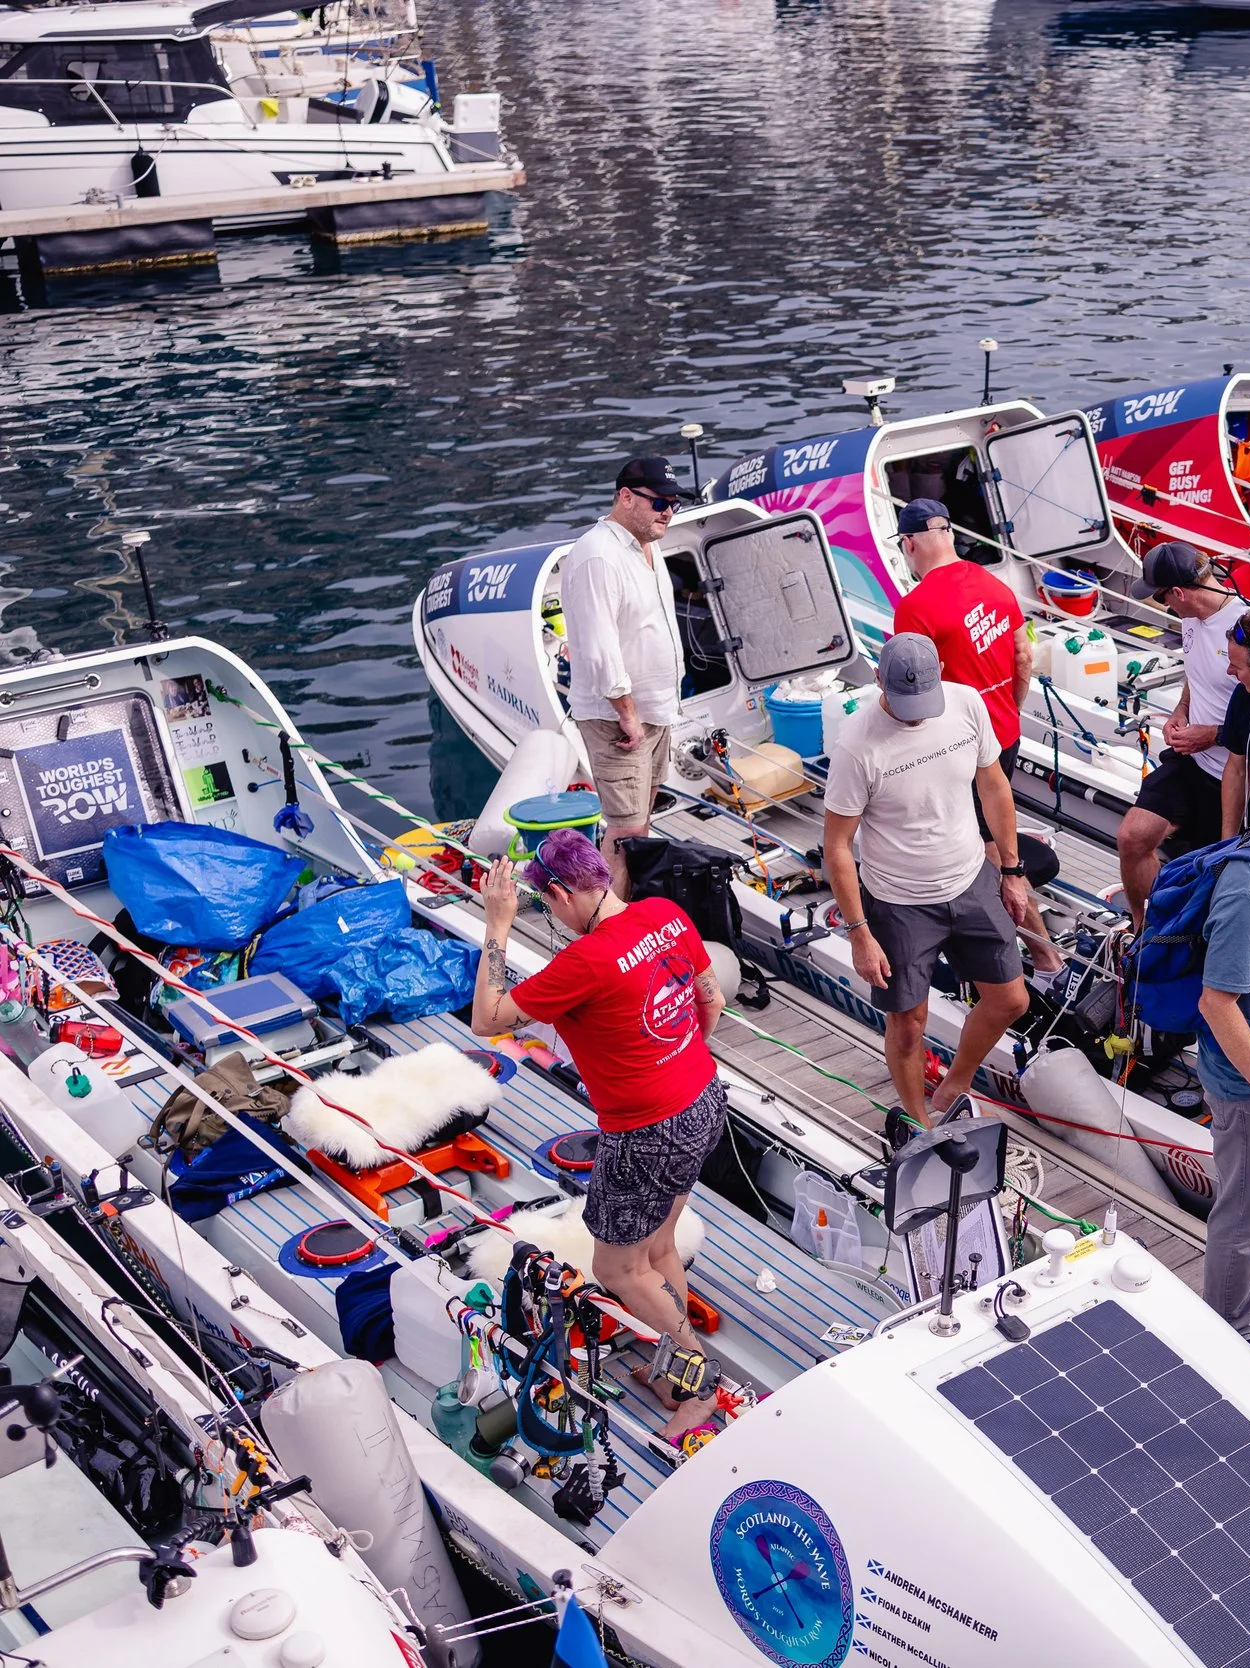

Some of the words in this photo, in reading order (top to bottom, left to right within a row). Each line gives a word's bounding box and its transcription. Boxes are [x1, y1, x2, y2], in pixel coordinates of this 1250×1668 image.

[1123, 388, 1186, 425] ROW
[729, 455, 766, 482] WORLD'S
[783, 439, 839, 478] ROW
[1168, 460, 1194, 476] GET
[727, 467, 768, 498] TOUGHEST
[1168, 474, 1201, 492] BUSY
[1168, 488, 1213, 507] LIVING!
[467, 562, 517, 603] ROW
[964, 602, 985, 629] GET
[969, 608, 997, 642] BUSY
[975, 614, 1011, 655] LIVING!
[487, 674, 541, 727] HADRIAN
[39, 756, 116, 786] WORLD'S
[888, 760, 916, 778] OCEAN
[916, 747, 948, 767] ROWING
[948, 733, 978, 752] COMPANY
[36, 767, 124, 800] TOUGHEST
[40, 781, 129, 825] ROW
[444, 1504, 470, 1532] BIO
[735, 1511, 791, 1540] SCOTLAND
[791, 1520, 816, 1550] THE
[808, 1546, 831, 1590] WAVE
[770, 1543, 795, 1561] ATLANTIC
[733, 1566, 761, 1621] WORLD'S
[760, 1618, 810, 1648] TOUGHEST
[808, 1612, 825, 1642] ROW
[877, 1596, 901, 1617] FIONA
[901, 1609, 931, 1634] DEAKIN
[884, 1569, 926, 1602] ANDRENA
[926, 1593, 973, 1629] MCSHANE
[972, 1617, 999, 1642] KERR
[871, 1622, 907, 1650] HEATHER
